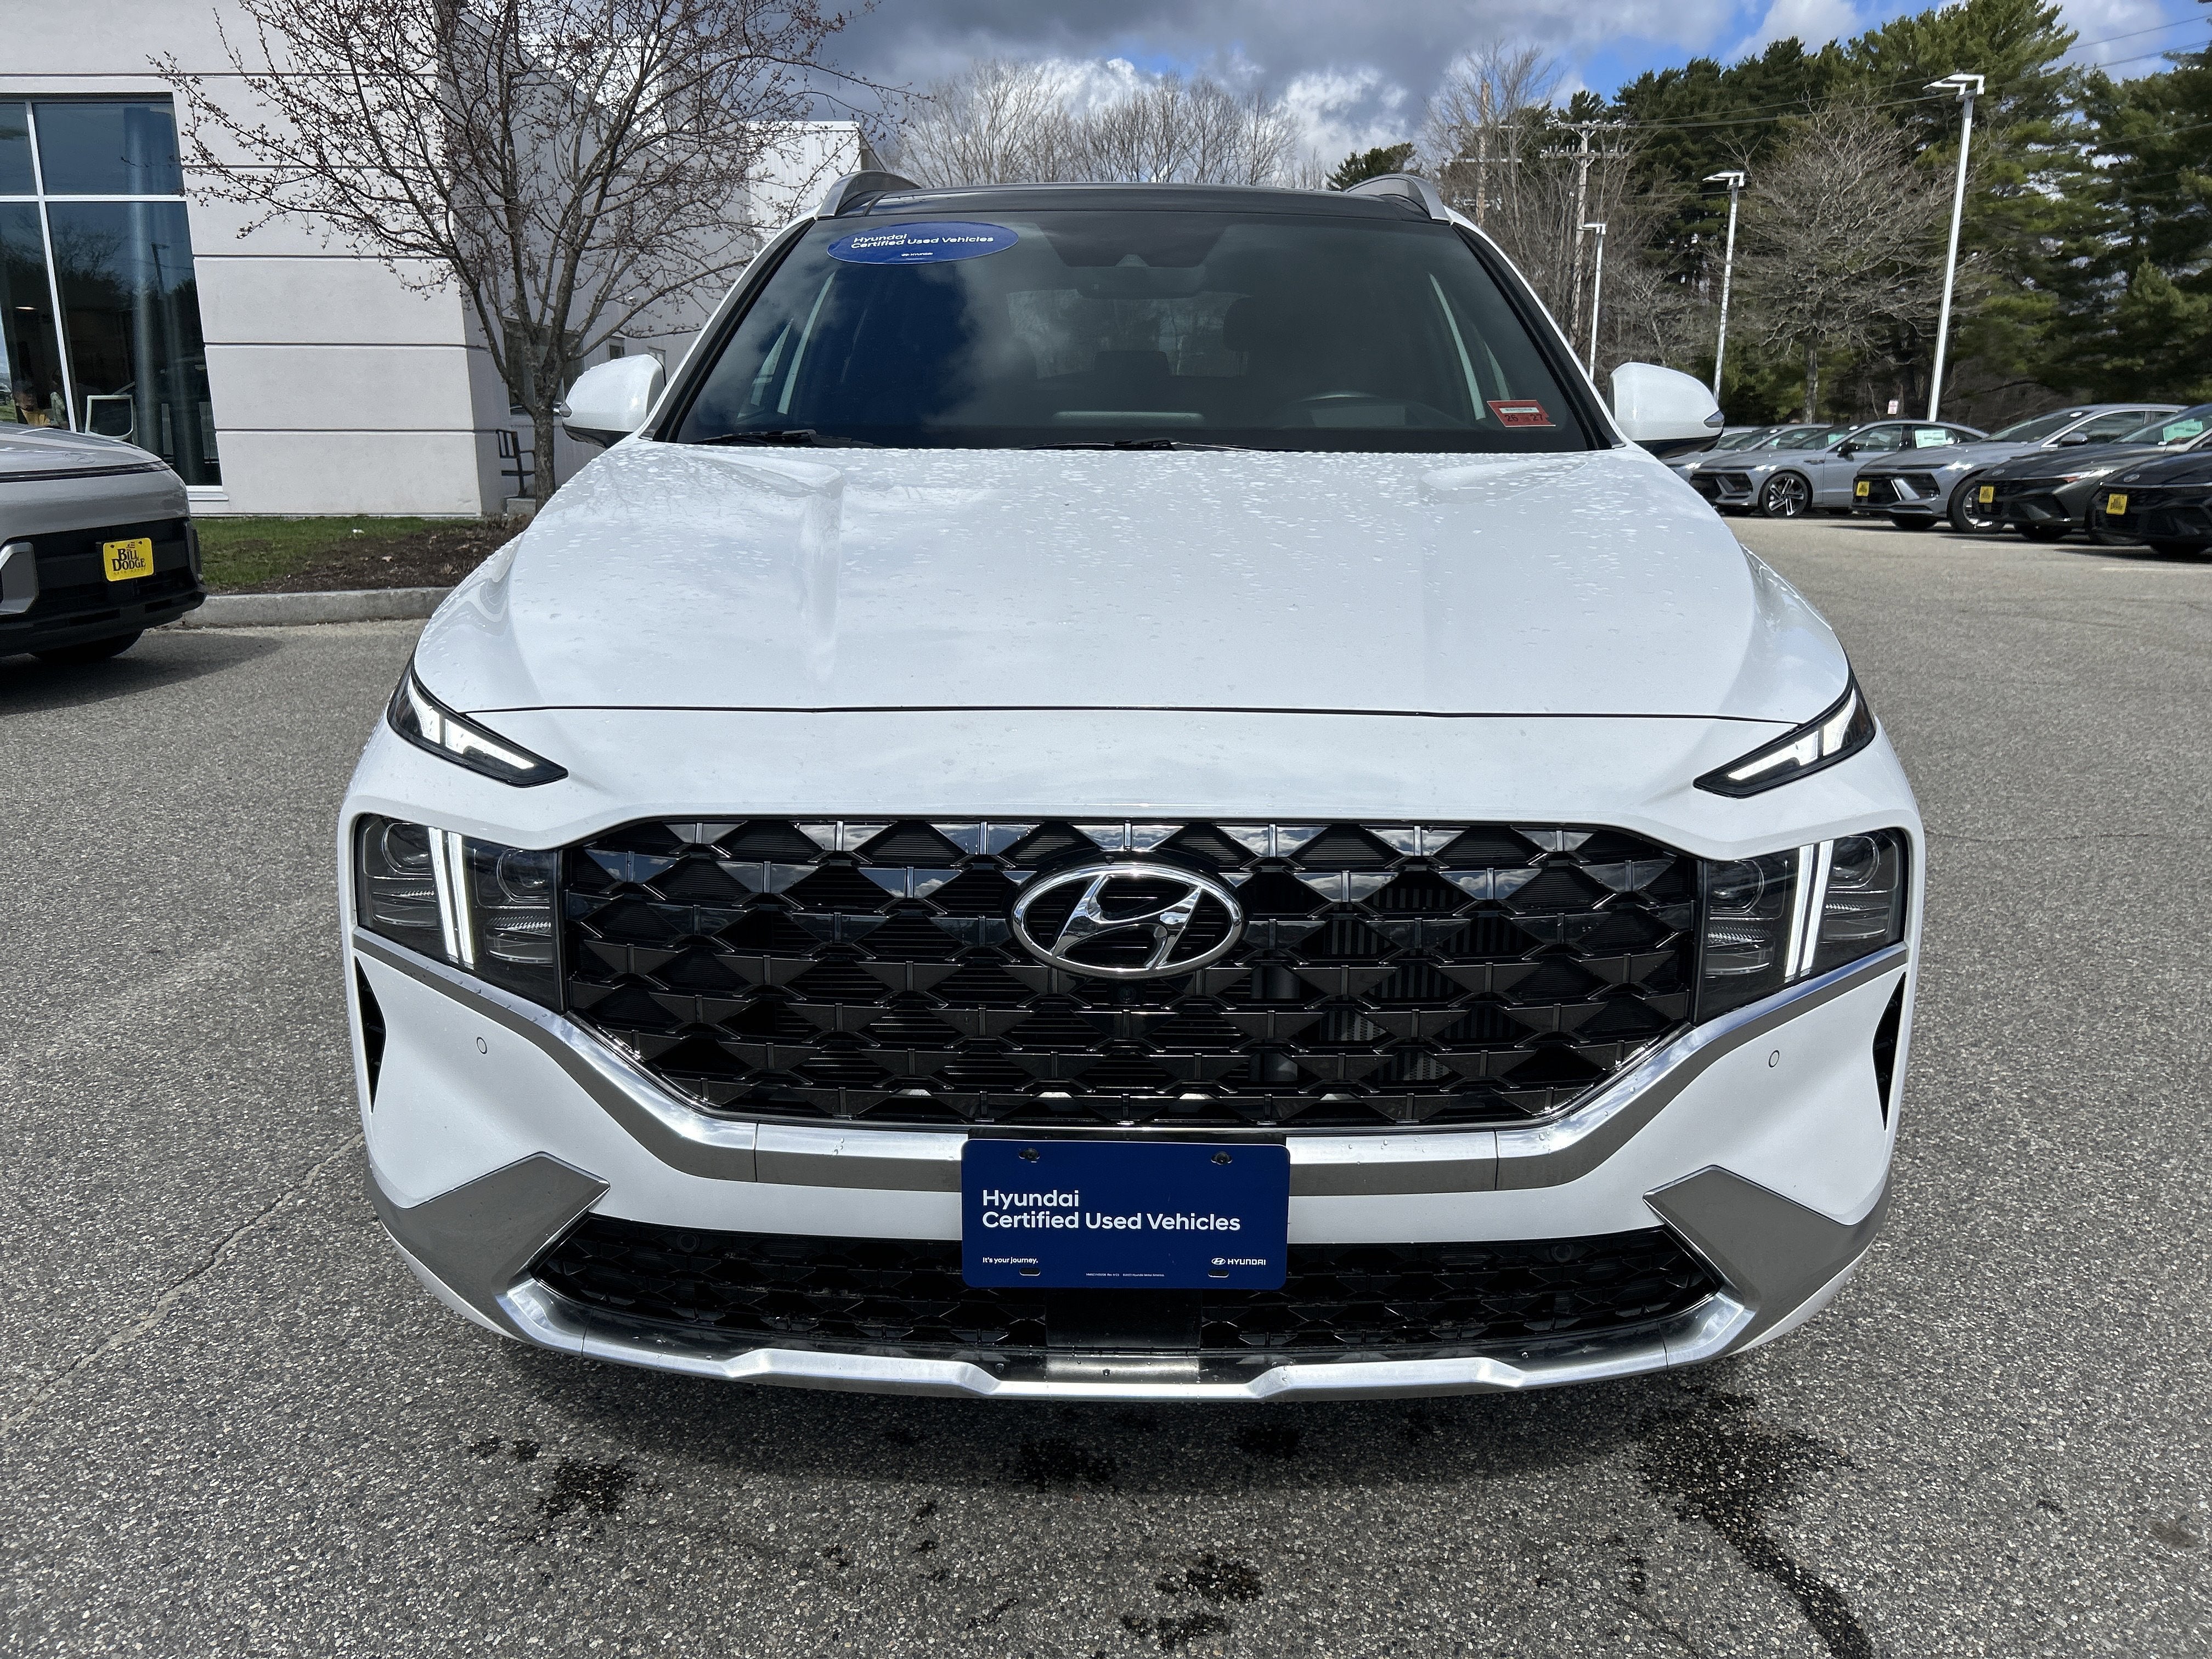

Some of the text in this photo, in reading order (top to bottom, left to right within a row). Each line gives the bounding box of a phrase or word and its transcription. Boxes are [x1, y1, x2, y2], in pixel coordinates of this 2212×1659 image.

[851, 239, 904, 249] Certified
[854, 234, 907, 243] Hyundai
[112, 558, 146, 571] DODGE
[982, 1189, 1079, 1210] Hyundai
[982, 1210, 1241, 1231] Certified Used Vehicles
[1010, 1256, 1039, 1265] journey.
